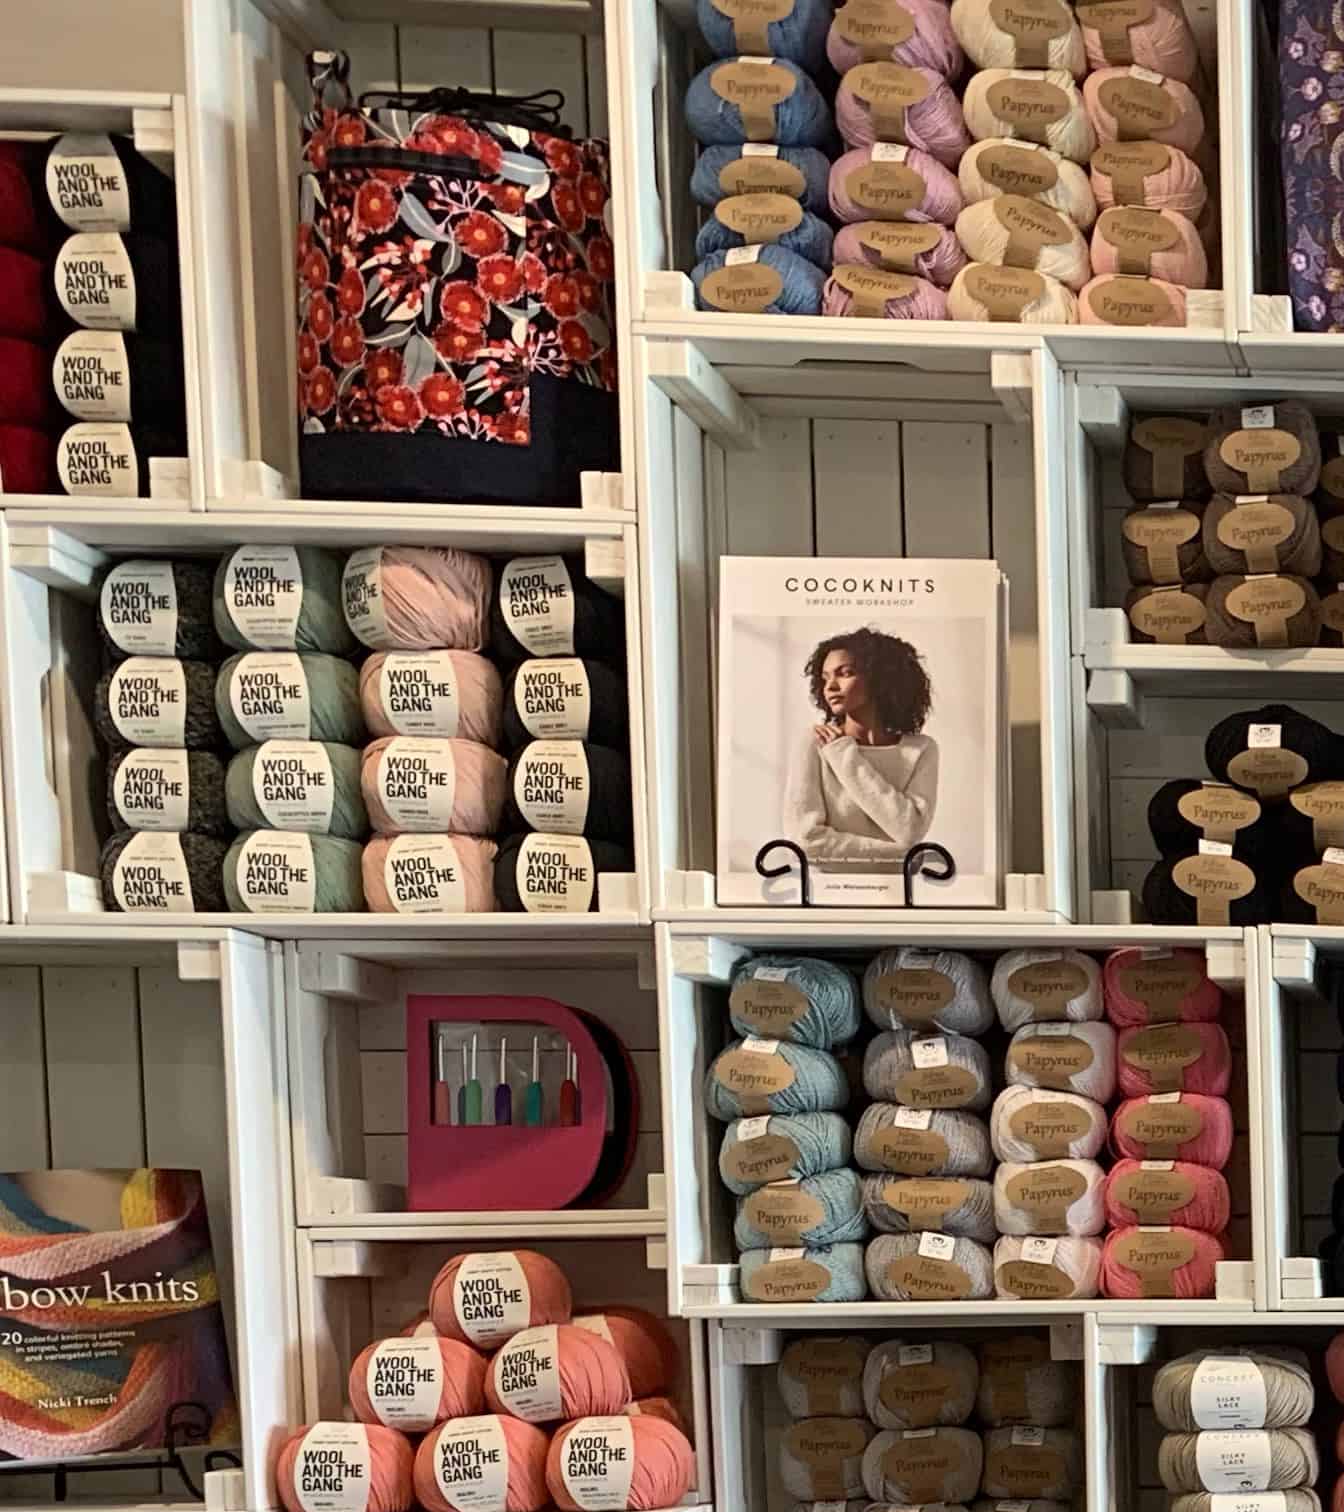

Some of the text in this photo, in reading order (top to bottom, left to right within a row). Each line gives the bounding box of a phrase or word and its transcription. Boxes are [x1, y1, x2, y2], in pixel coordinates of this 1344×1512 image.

[64, 261, 108, 274] WOOL
[65, 274, 127, 290] AND THE
[67, 289, 109, 304] GANG
[67, 442, 111, 456] WOOL
[67, 455, 130, 470] AND THE
[69, 469, 112, 485] GANG
[234, 566, 276, 580] WOOL
[234, 580, 295, 593] AND THE
[785, 577, 935, 593] COCOKNITS
[234, 593, 275, 607] GANG
[388, 670, 431, 683] WOOL
[389, 683, 450, 697] AND THE
[391, 698, 432, 712] GANG
[525, 761, 566, 776] WOOL
[524, 775, 583, 791] AND THE
[524, 789, 564, 804] GANG
[0, 1271, 199, 1310] bow knits
[460, 1278, 503, 1293] WOOL
[462, 1289, 522, 1306] AND THE
[463, 1305, 504, 1320] GANG
[1, 1332, 23, 1345] 20
[38, 1393, 118, 1409] Nicki Trench
[570, 1436, 609, 1449] WOOL
[568, 1448, 626, 1463] AND THE
[568, 1463, 607, 1477] GANG
